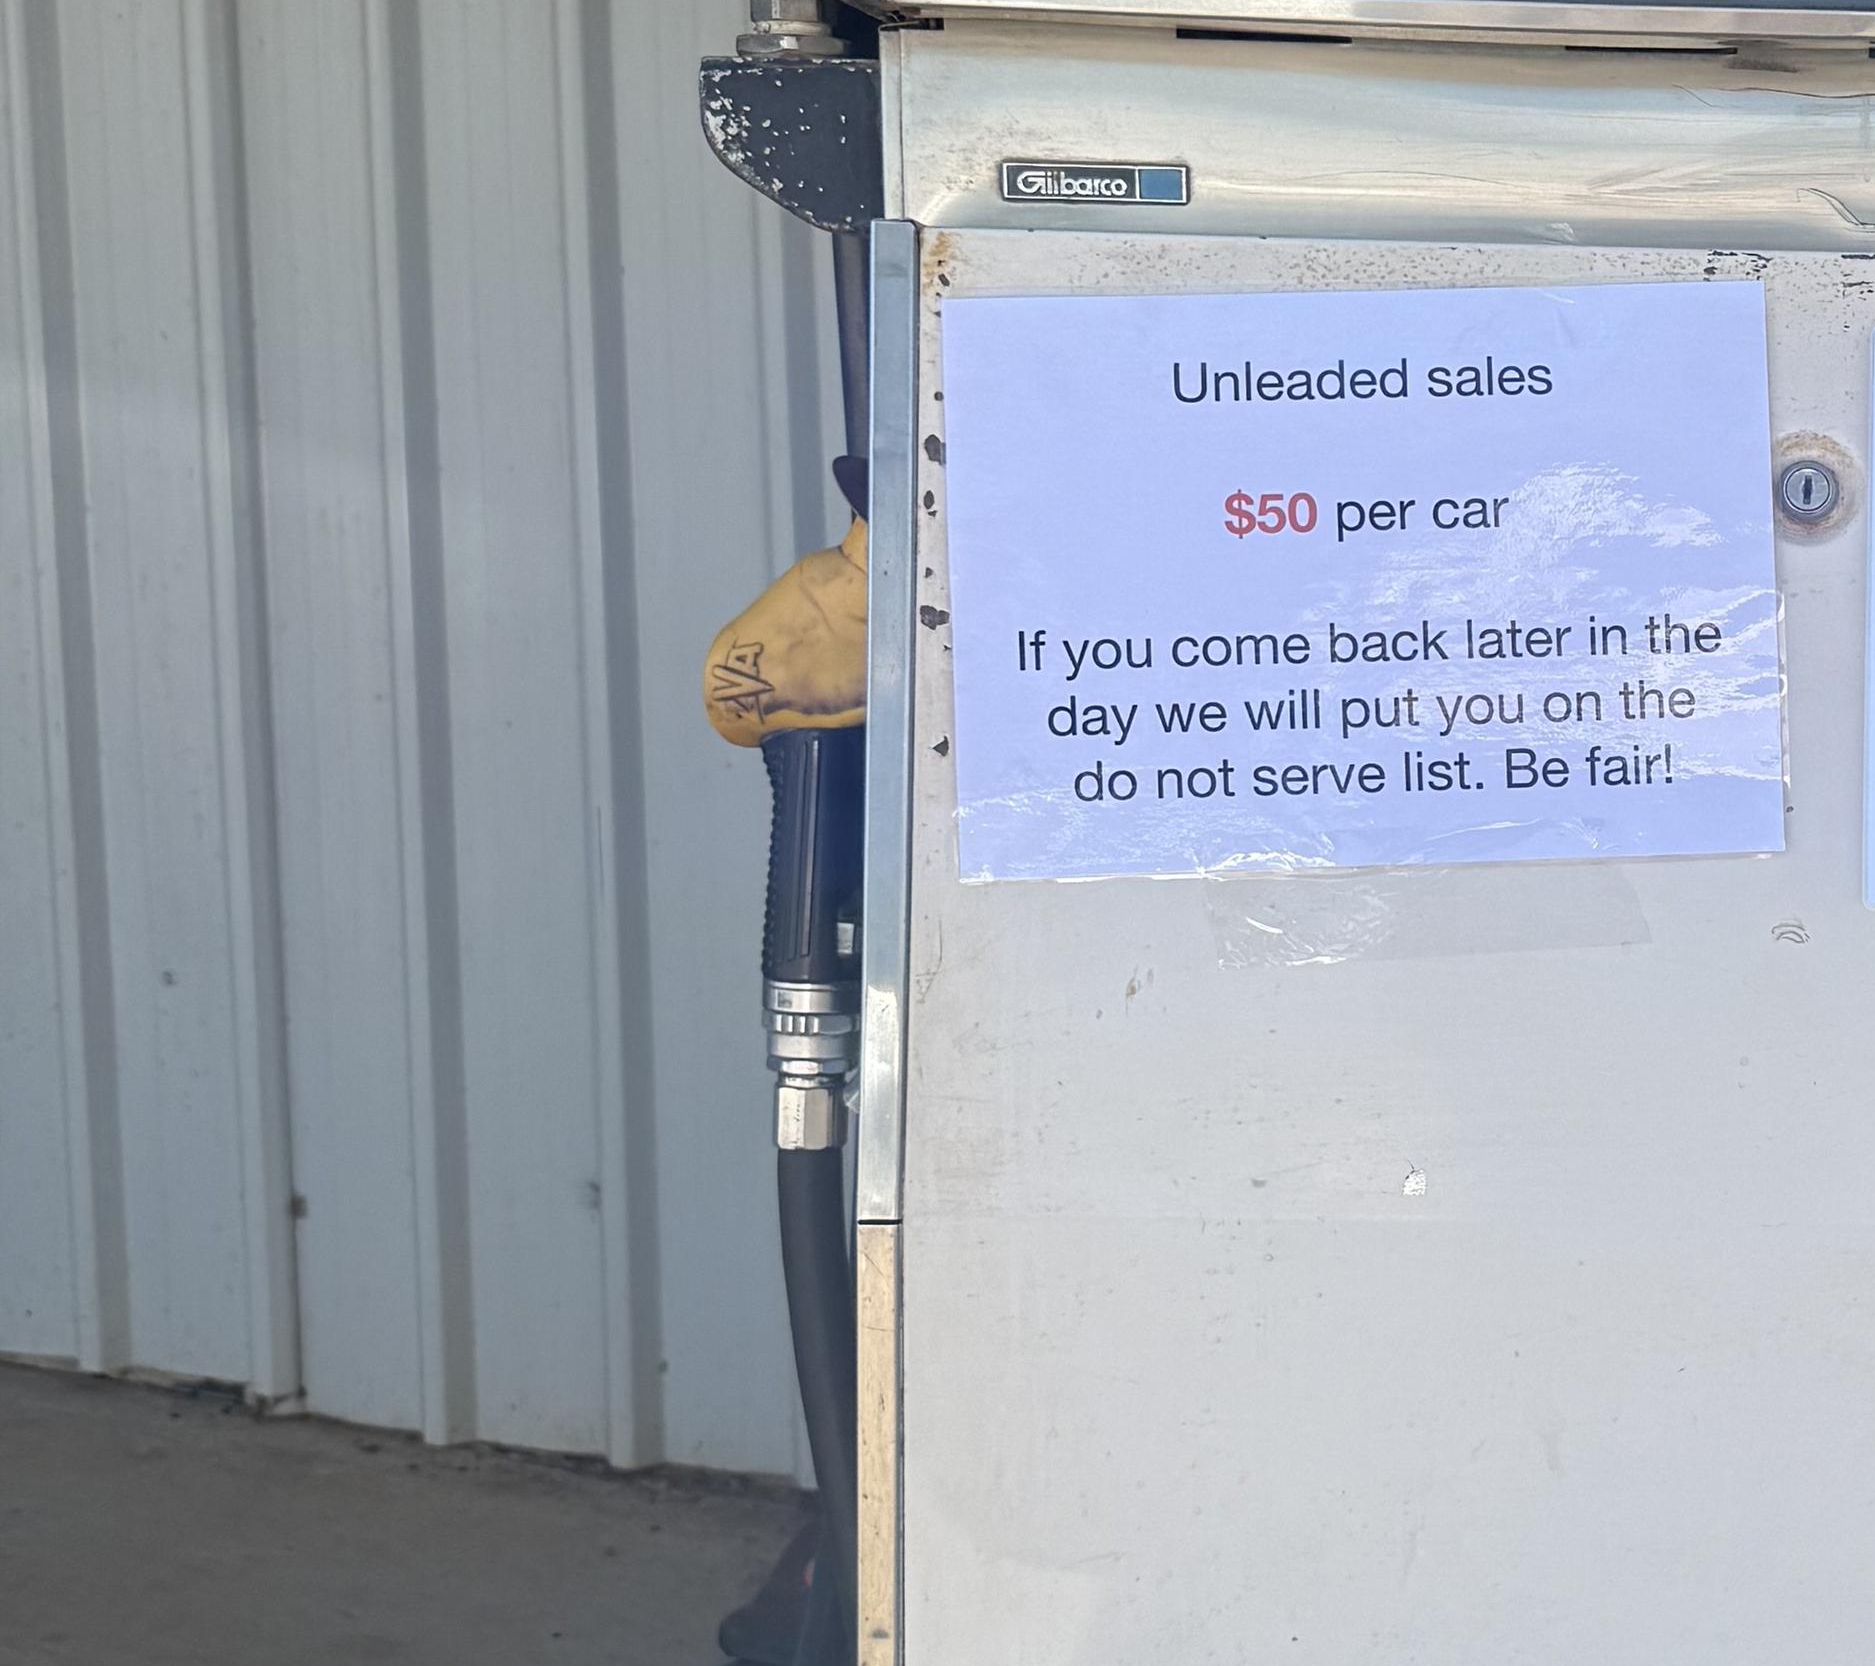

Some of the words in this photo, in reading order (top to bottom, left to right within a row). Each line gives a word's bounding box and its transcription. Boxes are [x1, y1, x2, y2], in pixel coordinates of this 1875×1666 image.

[1016, 171, 1128, 196] Gilbarco
[1173, 357, 1409, 404] Unleaded
[1427, 355, 1553, 398] sales
[1224, 488, 1318, 540] $50
[1336, 499, 1416, 543] per
[1432, 497, 1509, 531] car
[1018, 629, 1047, 672] If
[1061, 637, 1153, 682] you
[1171, 633, 1311, 668] come
[1329, 620, 1449, 664] back
[1466, 618, 1572, 660] later
[1589, 615, 1628, 656] in
[1645, 613, 1723, 654] the
[1047, 695, 1138, 746] day
[1155, 701, 1228, 734] we
[1244, 689, 1321, 731] will
[1341, 689, 1420, 740] put
[1435, 693, 1524, 737] you
[1542, 691, 1602, 724] on
[1618, 679, 1696, 722] the
[1074, 760, 1138, 803] do
[1157, 758, 1236, 800] not
[1252, 762, 1386, 797] serve
[1404, 750, 1486, 793] list.
[1505, 747, 1570, 789] Be
[1584, 743, 1673, 787] fair!
